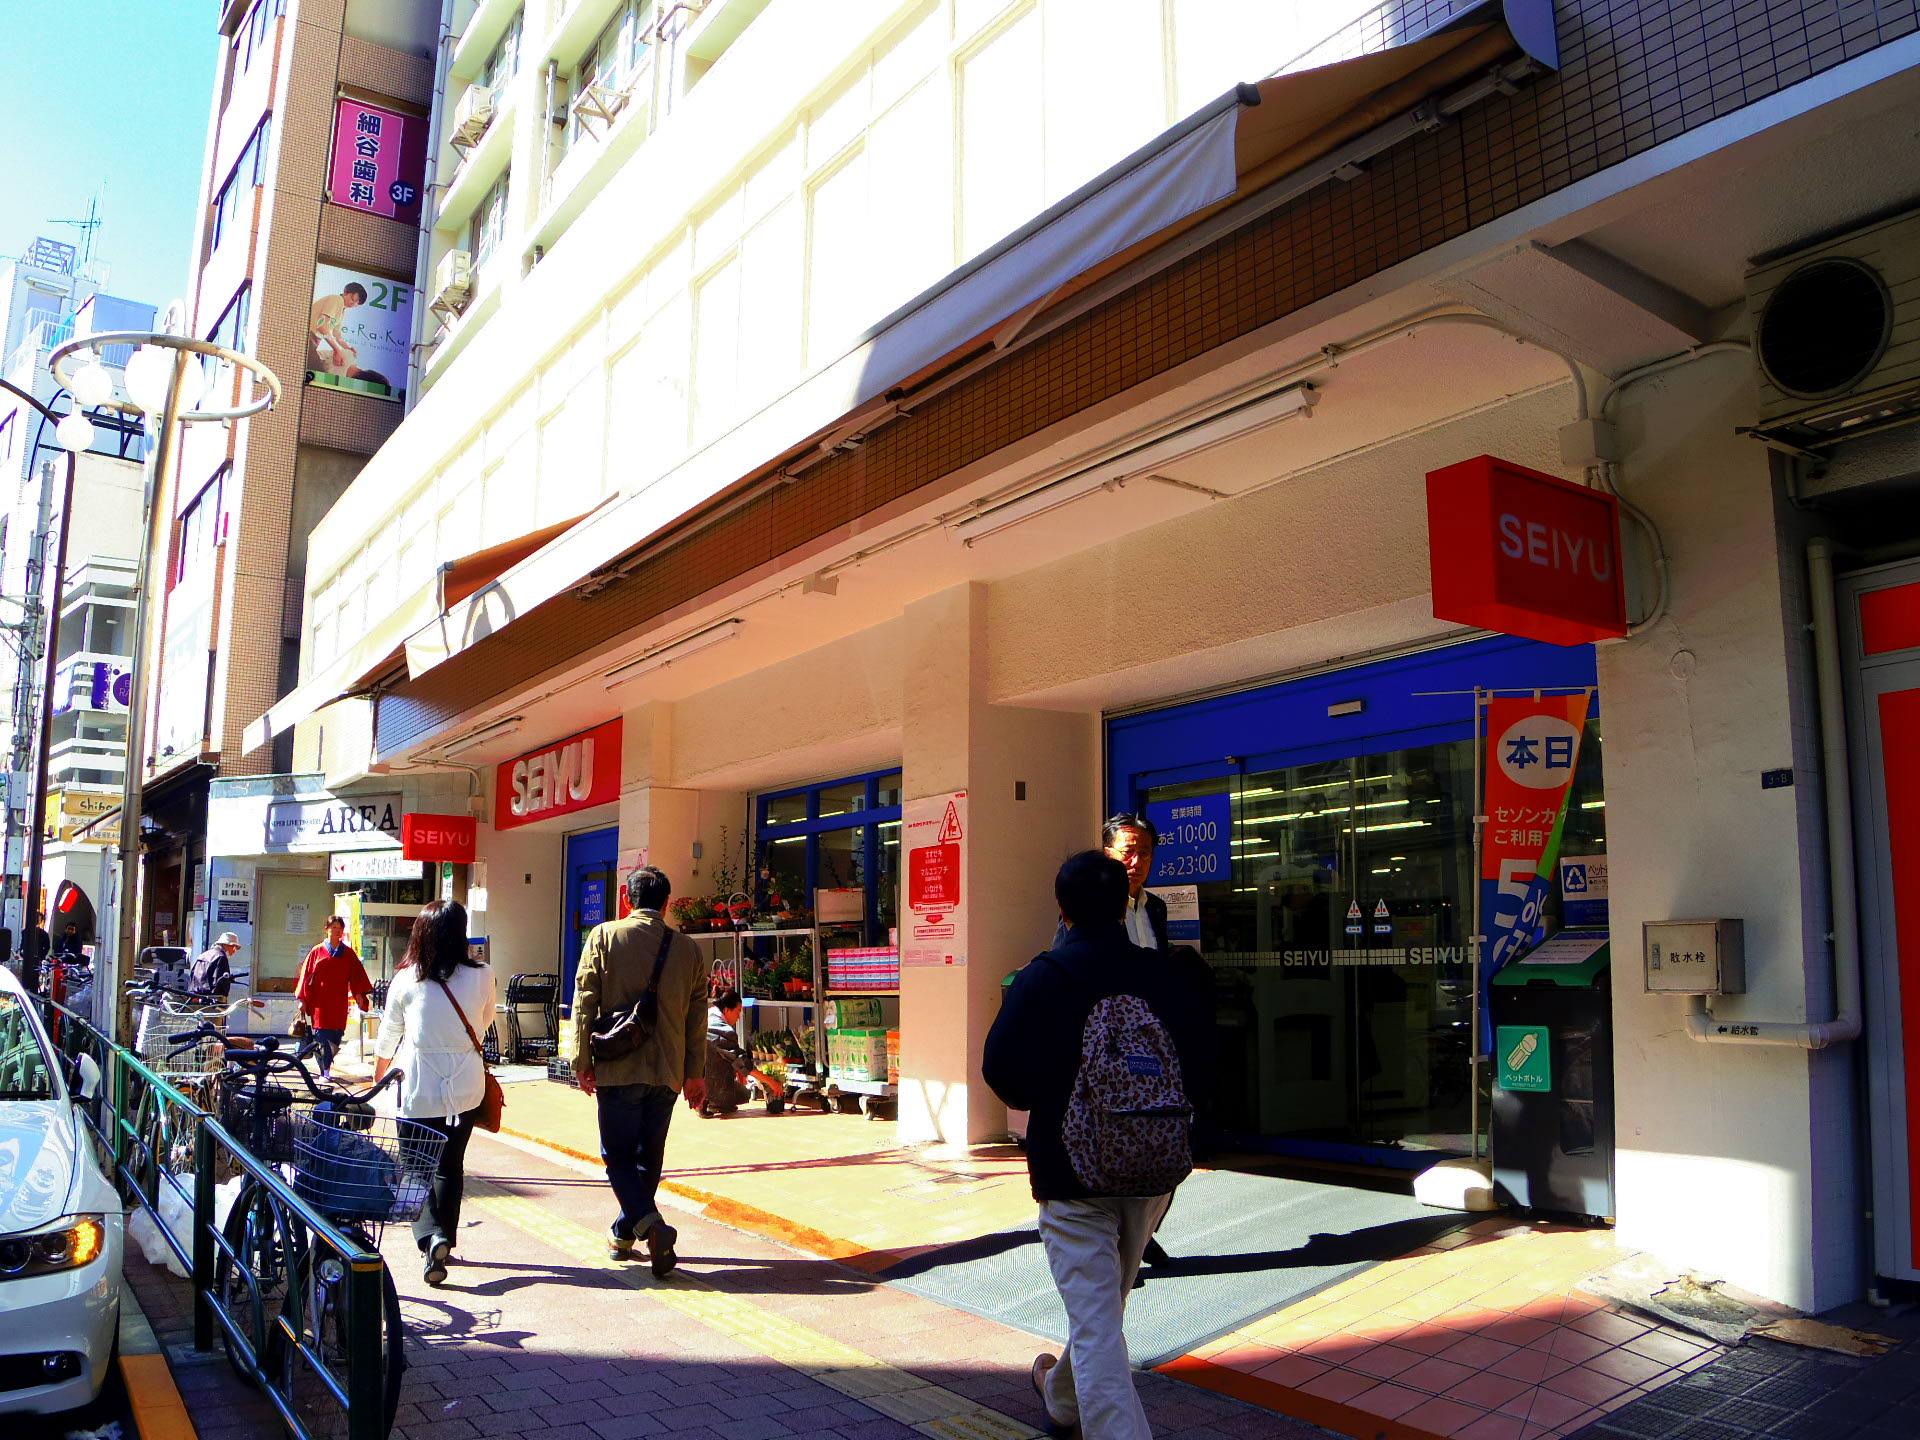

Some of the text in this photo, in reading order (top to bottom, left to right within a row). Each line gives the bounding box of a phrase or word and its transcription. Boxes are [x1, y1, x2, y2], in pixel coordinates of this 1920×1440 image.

[350, 111, 382, 207] 細谷歯科
[391, 184, 414, 202] 3F
[369, 282, 408, 312] 2F
[1500, 513, 1610, 582] SEIYU
[1506, 735, 1573, 769] 本日
[511, 738, 594, 816] SEIYU
[318, 803, 399, 834] AREA
[1171, 805, 1202, 820] 営業時間
[413, 829, 470, 846] SEIYU
[1283, 951, 1329, 966] SEIYU
[1409, 947, 1464, 964] SEIYU
[1670, 952, 1706, 963] 散水栓
[1505, 1073, 1543, 1083] ペットボトル
